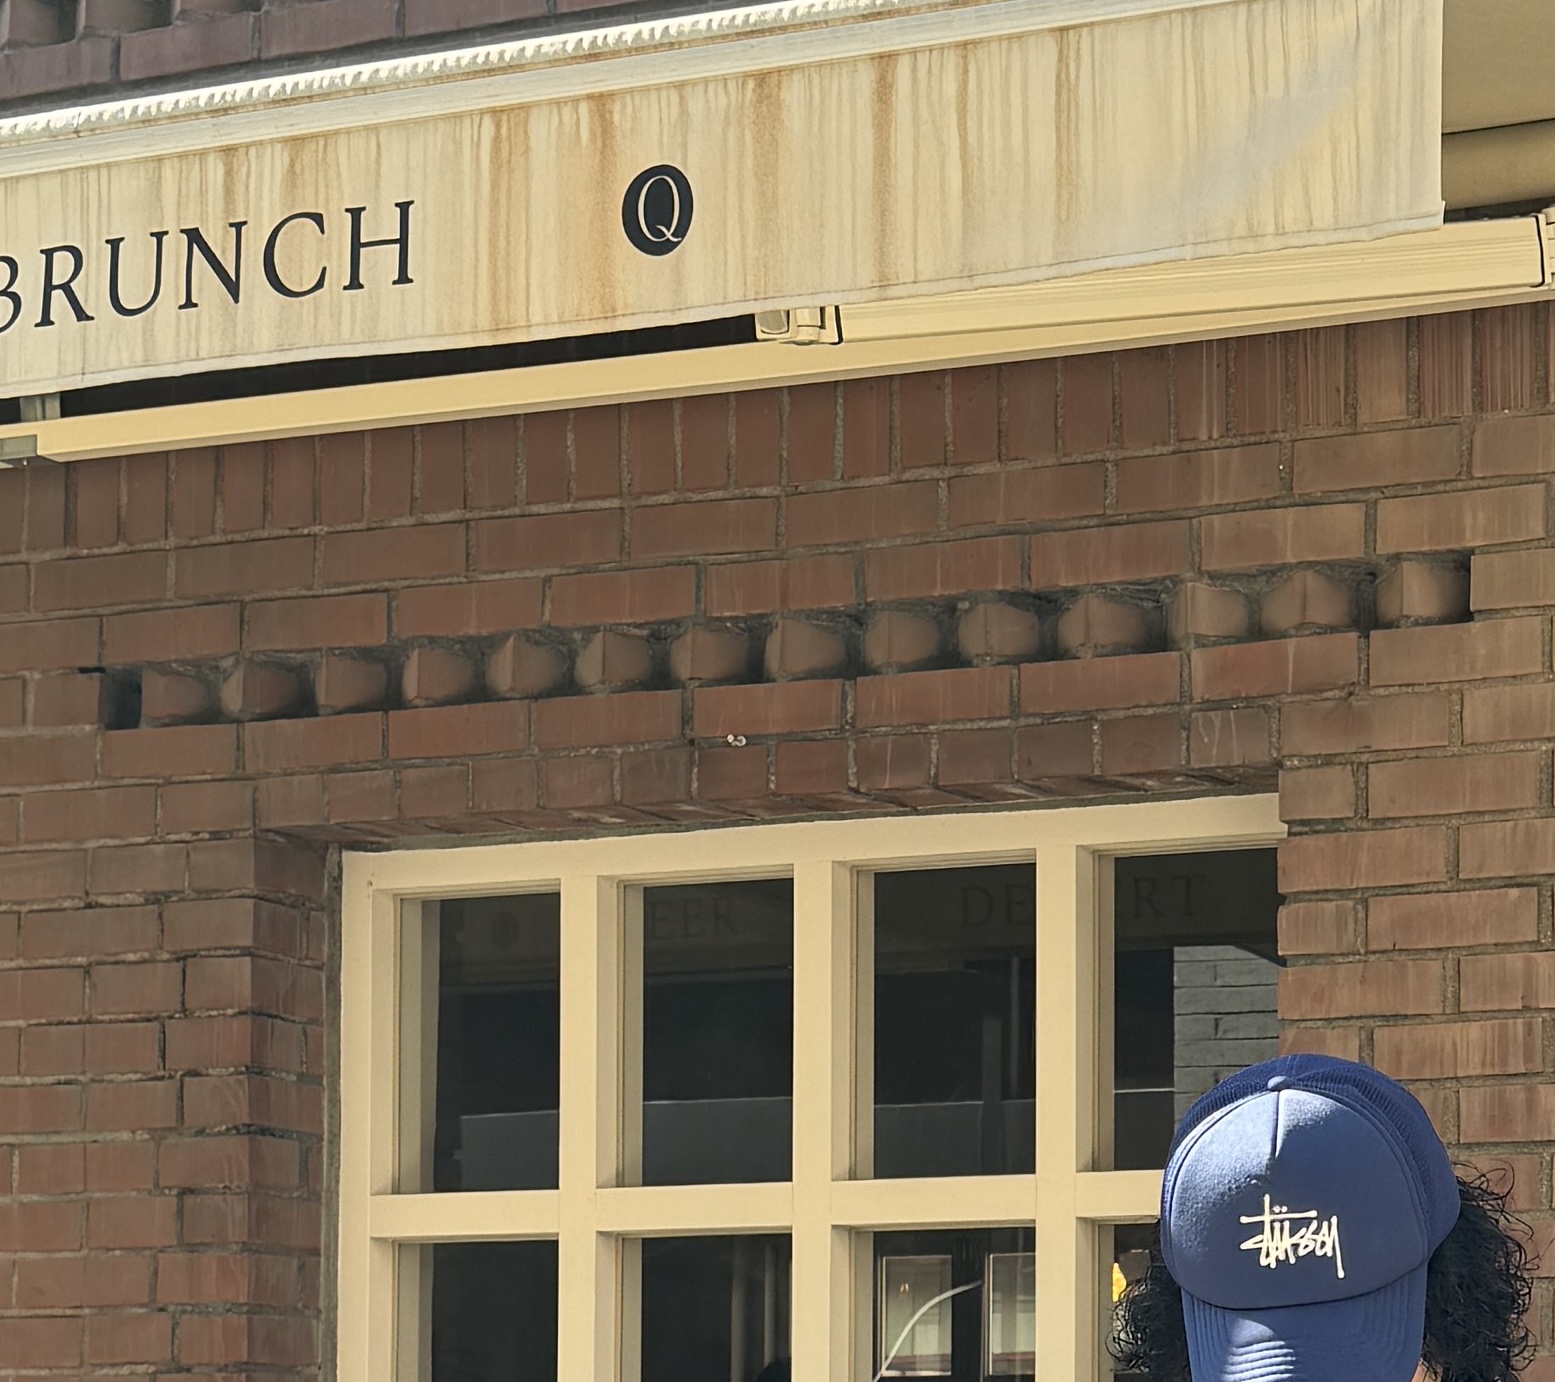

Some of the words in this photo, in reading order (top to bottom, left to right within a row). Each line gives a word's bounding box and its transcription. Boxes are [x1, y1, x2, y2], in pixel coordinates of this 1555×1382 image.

[637, 174, 683, 242] Q
[648, 895, 741, 940] EER
[961, 873, 1207, 929] DERT
